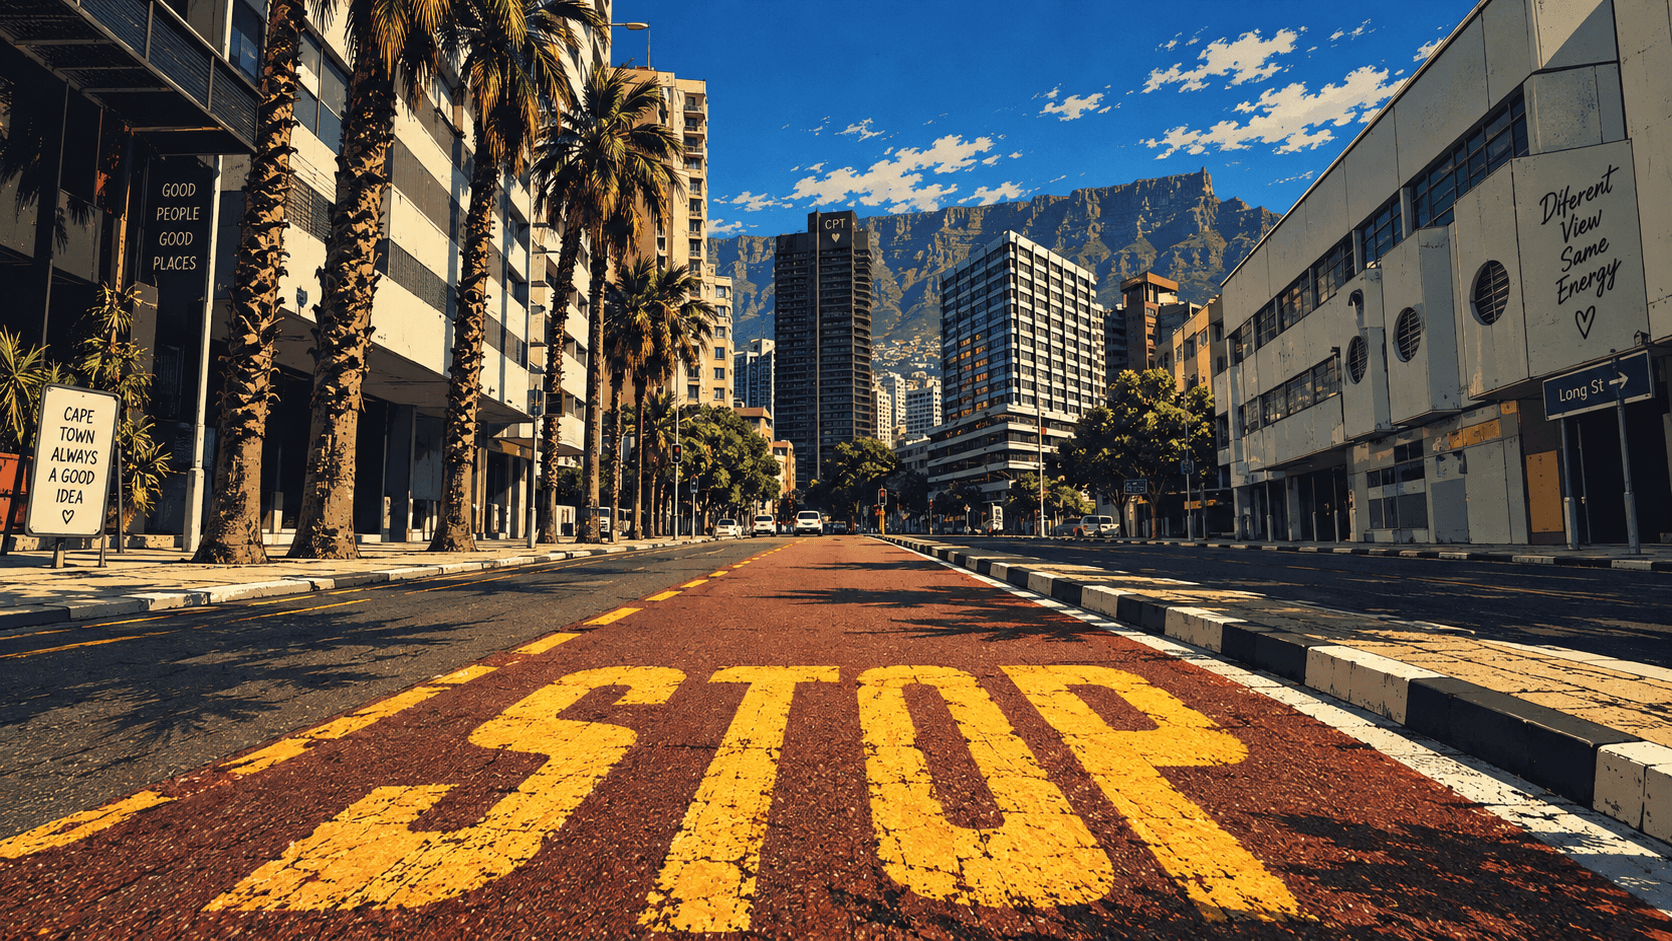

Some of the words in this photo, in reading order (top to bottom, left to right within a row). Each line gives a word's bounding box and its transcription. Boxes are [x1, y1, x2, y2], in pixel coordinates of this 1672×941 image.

[162, 182, 196, 197] GOOD
[156, 206, 200, 221] PEOPLE
[825, 218, 846, 230] CPT
[1559, 209, 1603, 244] View
[159, 231, 194, 246] GOOD
[153, 256, 197, 270] PLACES
[1560, 237, 1610, 273] Same
[1555, 257, 1622, 305] Energy
[1559, 385, 1588, 402] Long
[1590, 378, 1605, 395] St
[63, 406, 95, 424] CAPE
[60, 426, 96, 444] TOWN
[50, 446, 98, 465] ALWAYS
[48, 467, 57, 483] A
[60, 468, 95, 485] GOOD
[55, 488, 83, 504] IDEA
[203, 664, 1322, 934] STOP
